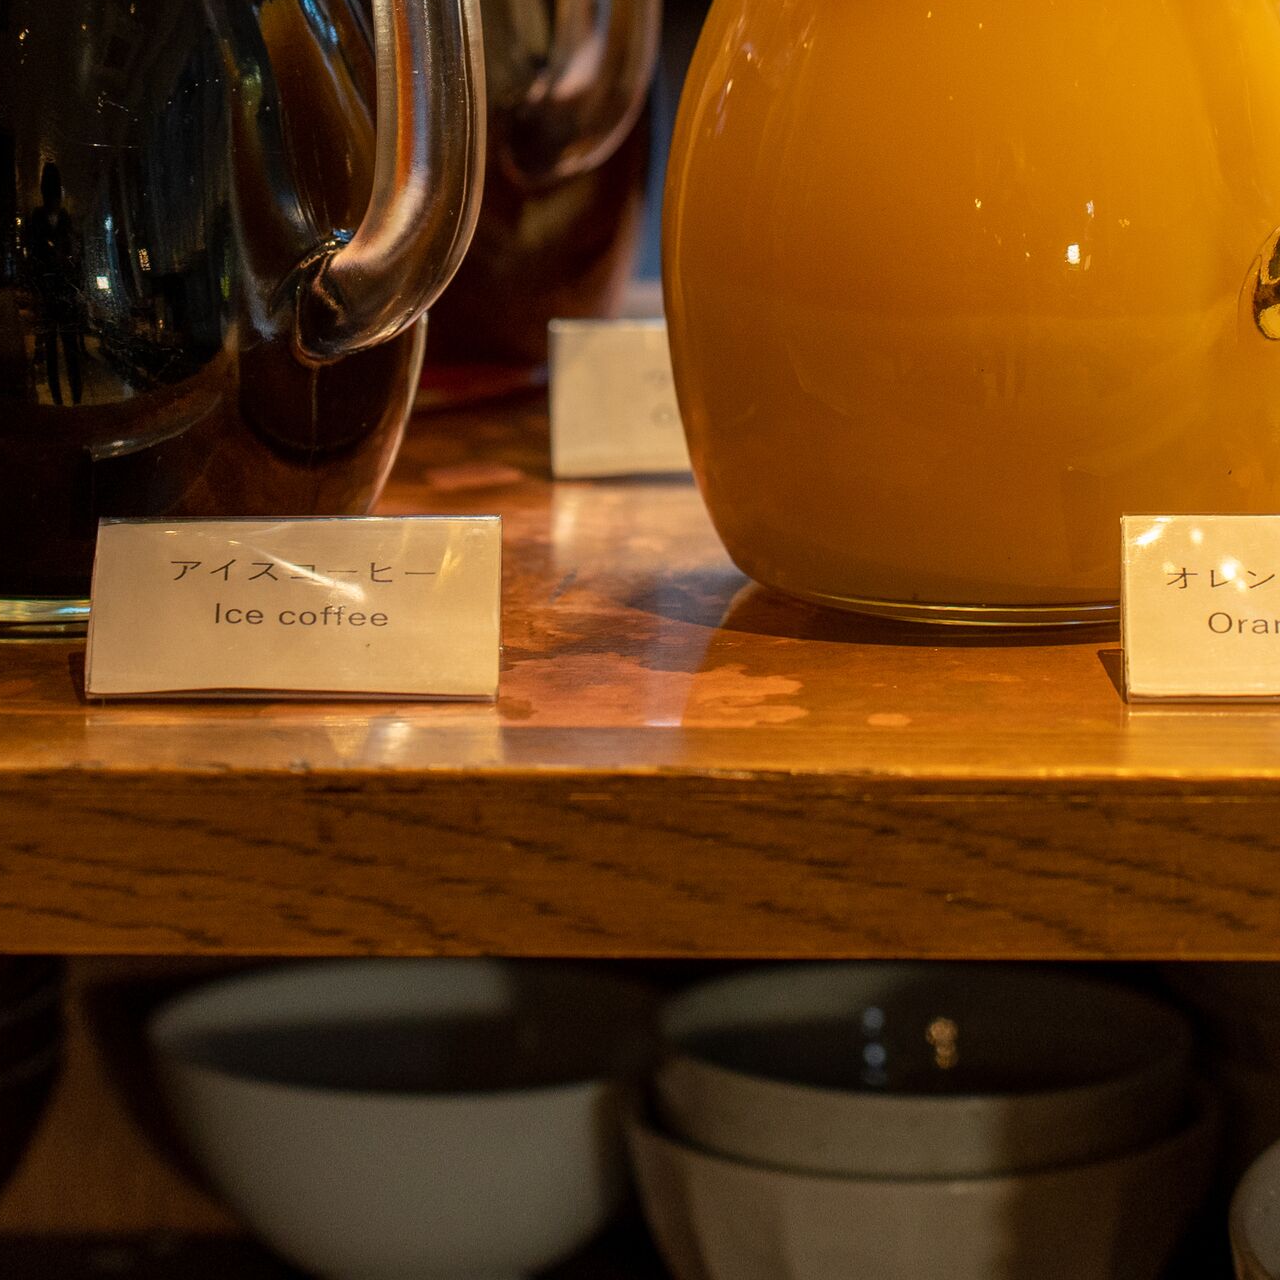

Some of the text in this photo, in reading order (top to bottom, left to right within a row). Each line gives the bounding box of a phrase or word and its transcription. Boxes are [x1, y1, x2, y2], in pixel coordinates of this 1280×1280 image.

[170, 558, 437, 584] アイスコーヒー
[214, 602, 389, 628] Ice coffee
